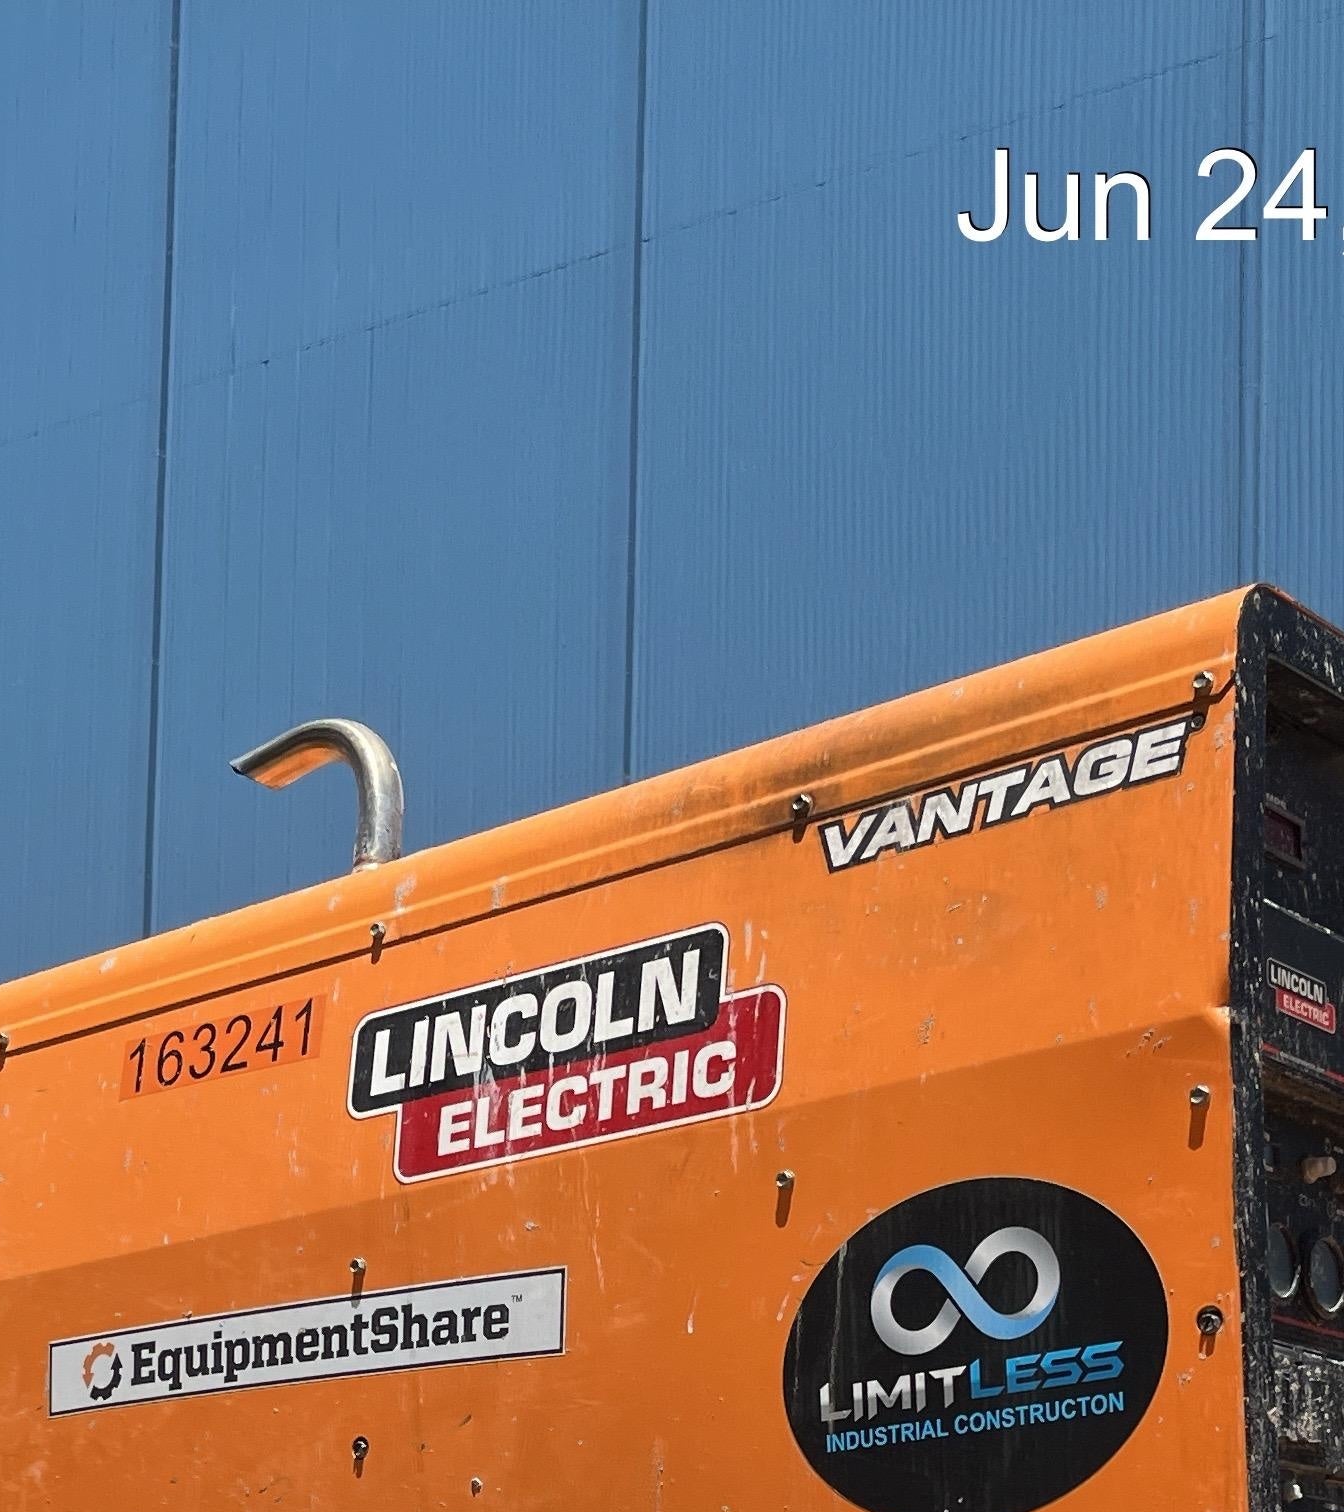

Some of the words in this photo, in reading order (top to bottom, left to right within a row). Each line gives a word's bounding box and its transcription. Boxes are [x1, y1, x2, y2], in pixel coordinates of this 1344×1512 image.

[823, 721, 1188, 868] VANTAGE
[369, 948, 702, 1097] LINCOLN
[1270, 964, 1323, 1003] LINCOLN
[1283, 994, 1329, 1025] ELECTRIC
[128, 998, 313, 1092] 163241
[437, 1039, 737, 1156] ELECTRIC
[131, 1303, 509, 1390] EquipmentShare
[820, 1341, 1124, 1422] LIMITLESS
[826, 1419, 949, 1453] INDUSTRIAL
[955, 1392, 1124, 1434] CONSTRUCTON
